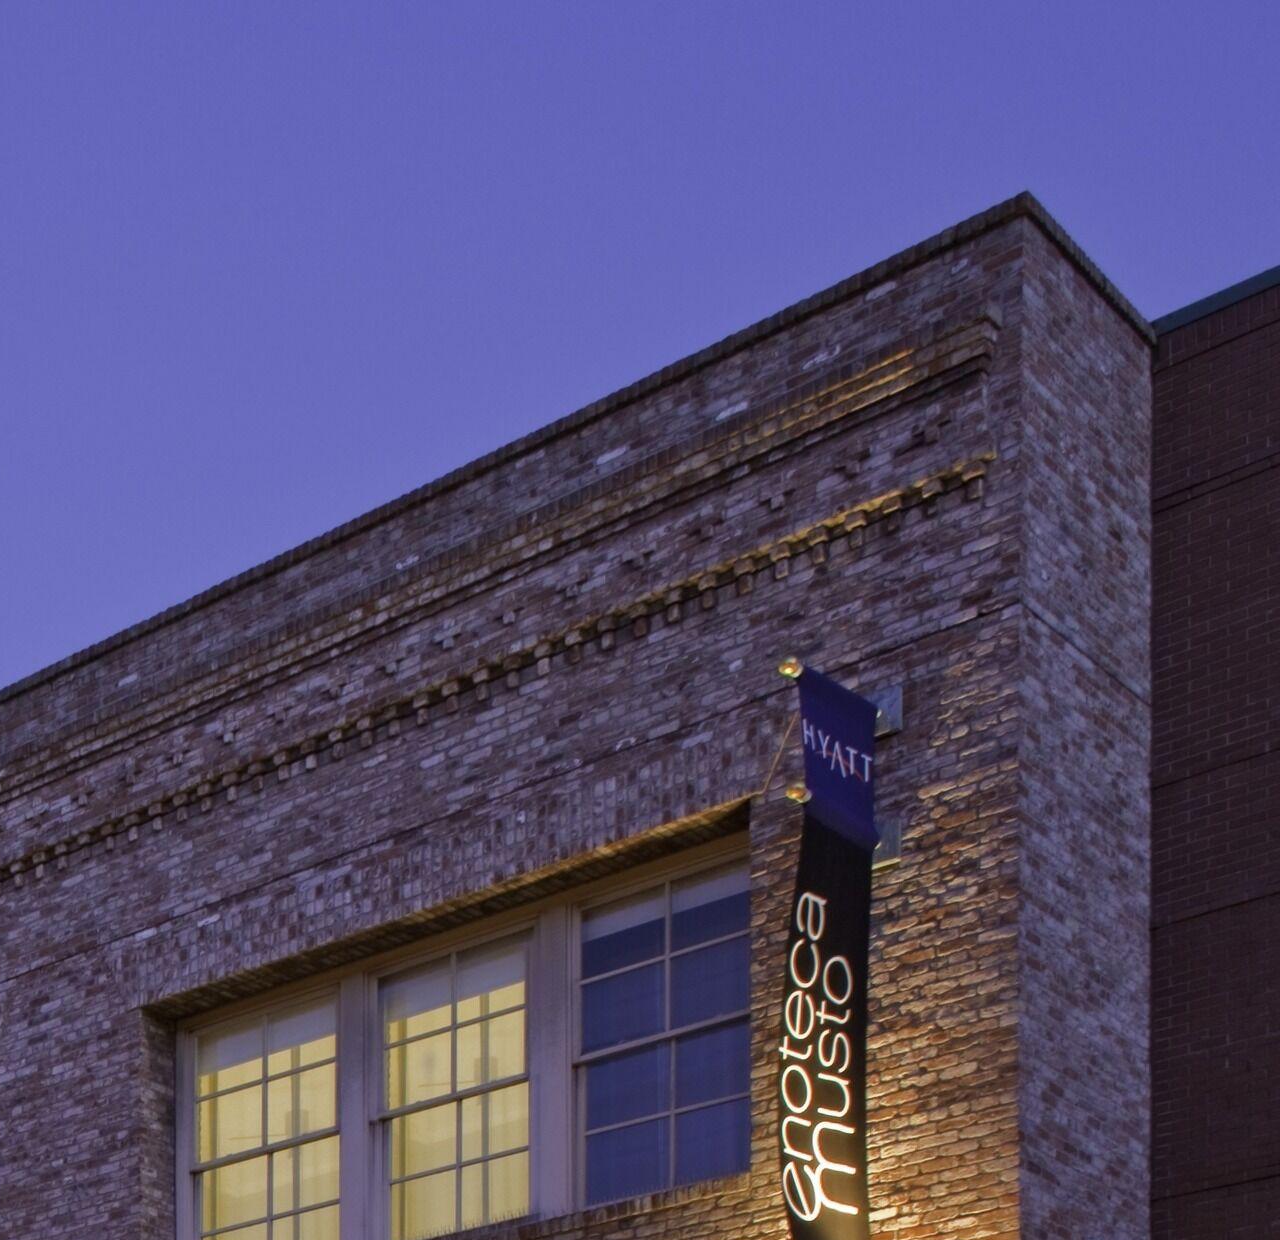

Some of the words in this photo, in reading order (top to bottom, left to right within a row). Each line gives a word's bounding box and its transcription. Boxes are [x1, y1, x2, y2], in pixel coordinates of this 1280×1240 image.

[802, 718, 873, 782] HYATT
[778, 890, 827, 1222] enoteca
[812, 955, 859, 1216] musto
